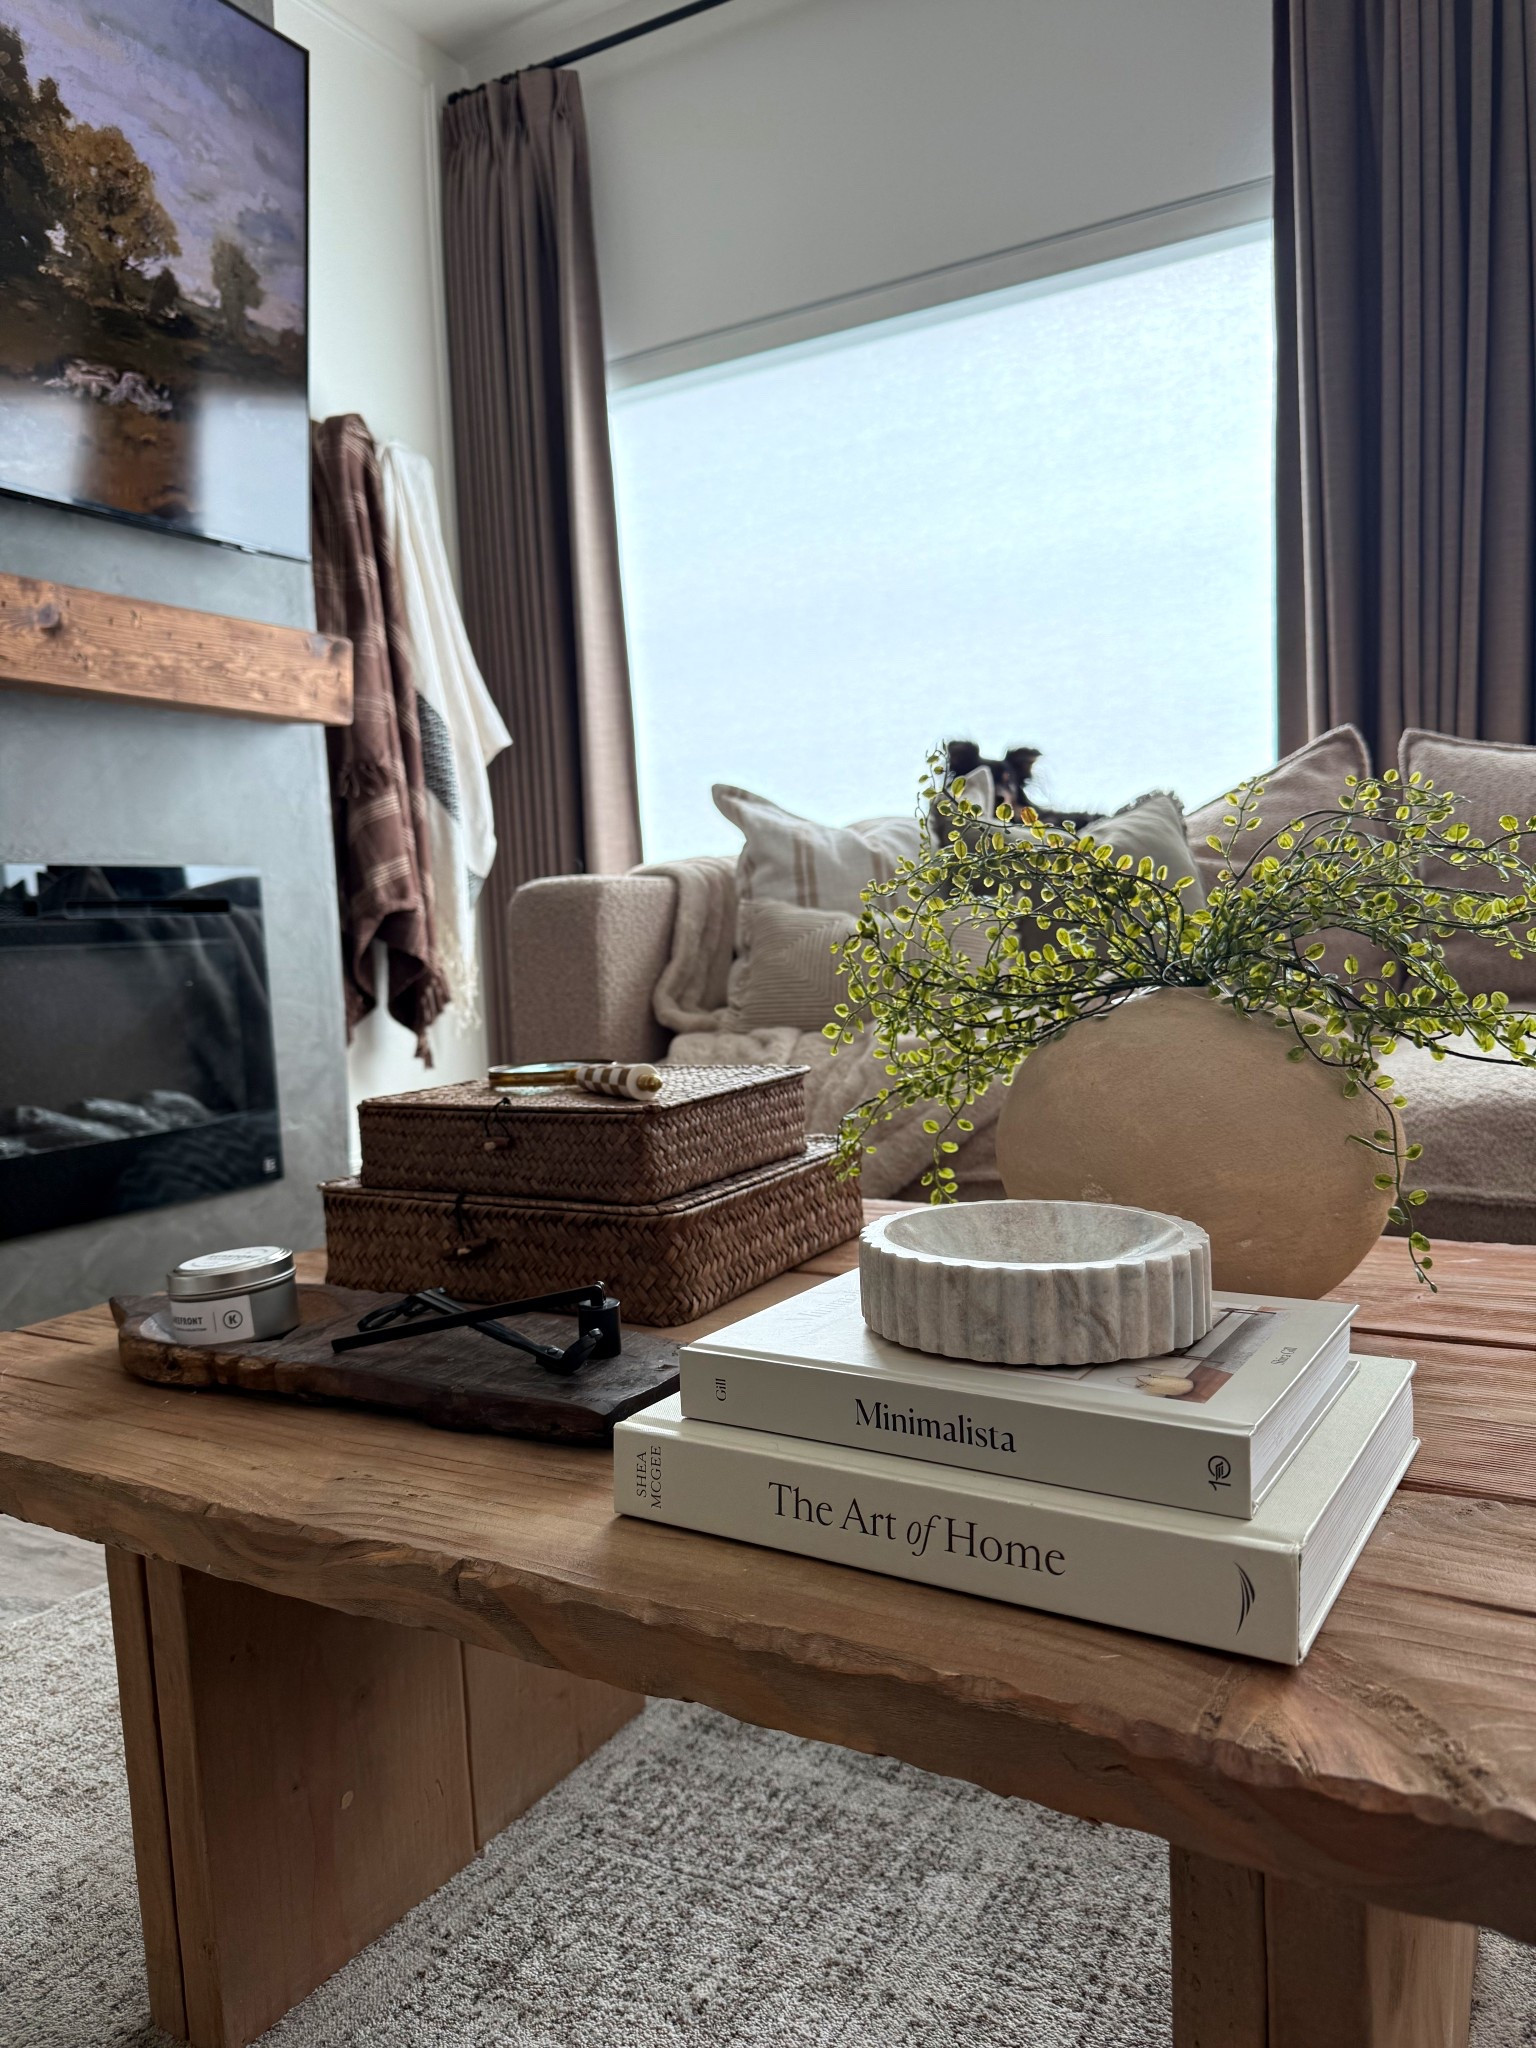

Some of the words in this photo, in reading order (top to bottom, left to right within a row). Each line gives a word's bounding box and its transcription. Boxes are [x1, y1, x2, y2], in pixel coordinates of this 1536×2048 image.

[715, 1378, 727, 1401] Gill
[855, 1398, 1017, 1453] Minimalista
[636, 1451, 647, 1498] SHEA
[650, 1445, 662, 1509] MCGEE
[768, 1481, 833, 1526] The
[839, 1497, 897, 1540] Art
[906, 1514, 941, 1557] of
[944, 1516, 1066, 1576] Home
